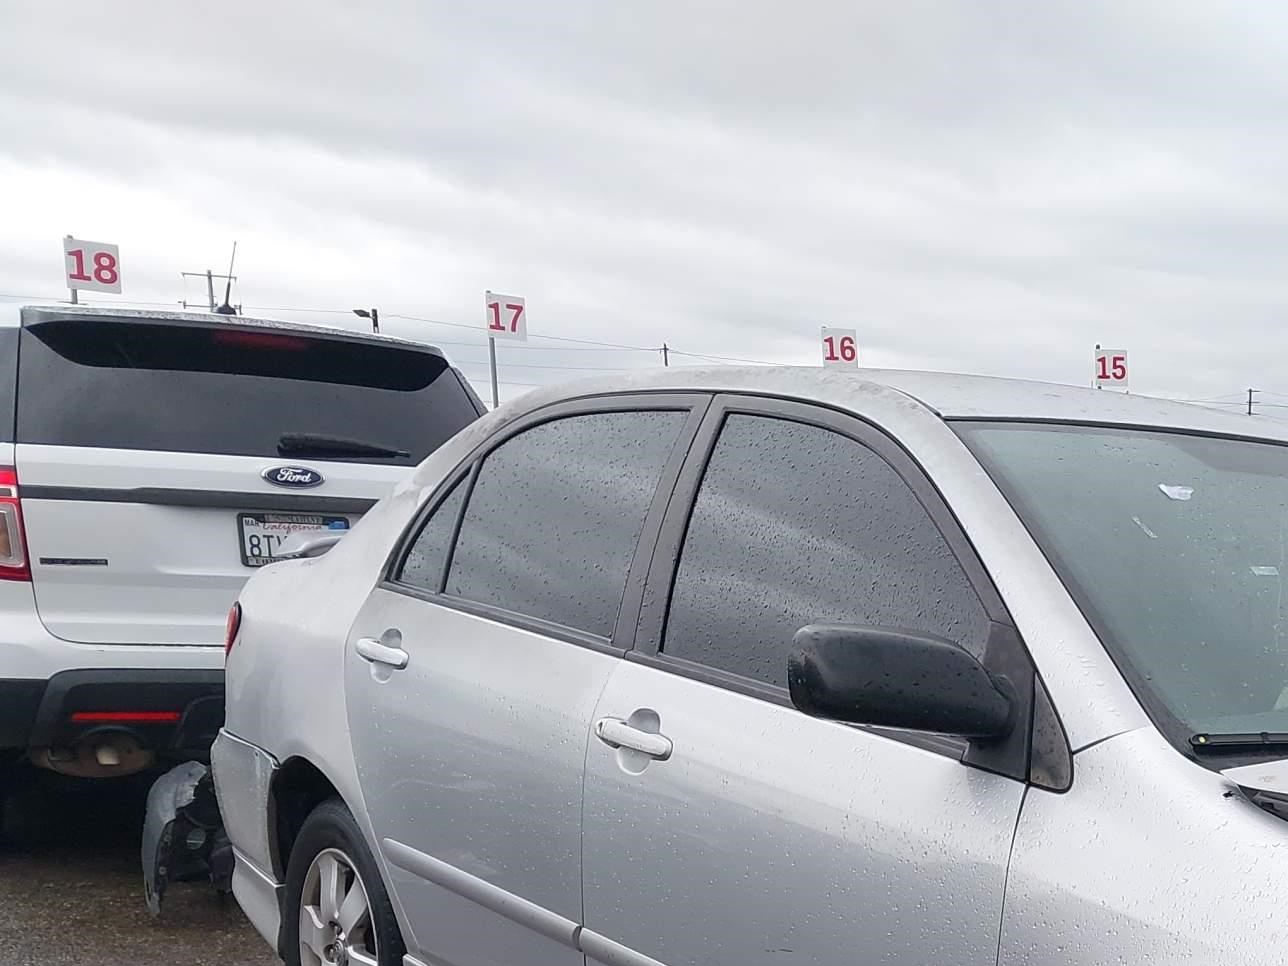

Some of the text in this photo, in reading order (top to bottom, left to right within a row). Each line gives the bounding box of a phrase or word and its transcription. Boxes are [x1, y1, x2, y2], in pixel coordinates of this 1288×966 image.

[67, 249, 118, 285] 18
[488, 302, 524, 332] 17
[824, 336, 856, 362] 16
[1097, 356, 1126, 380] 15
[277, 468, 312, 482] Ford
[263, 522, 322, 534] California
